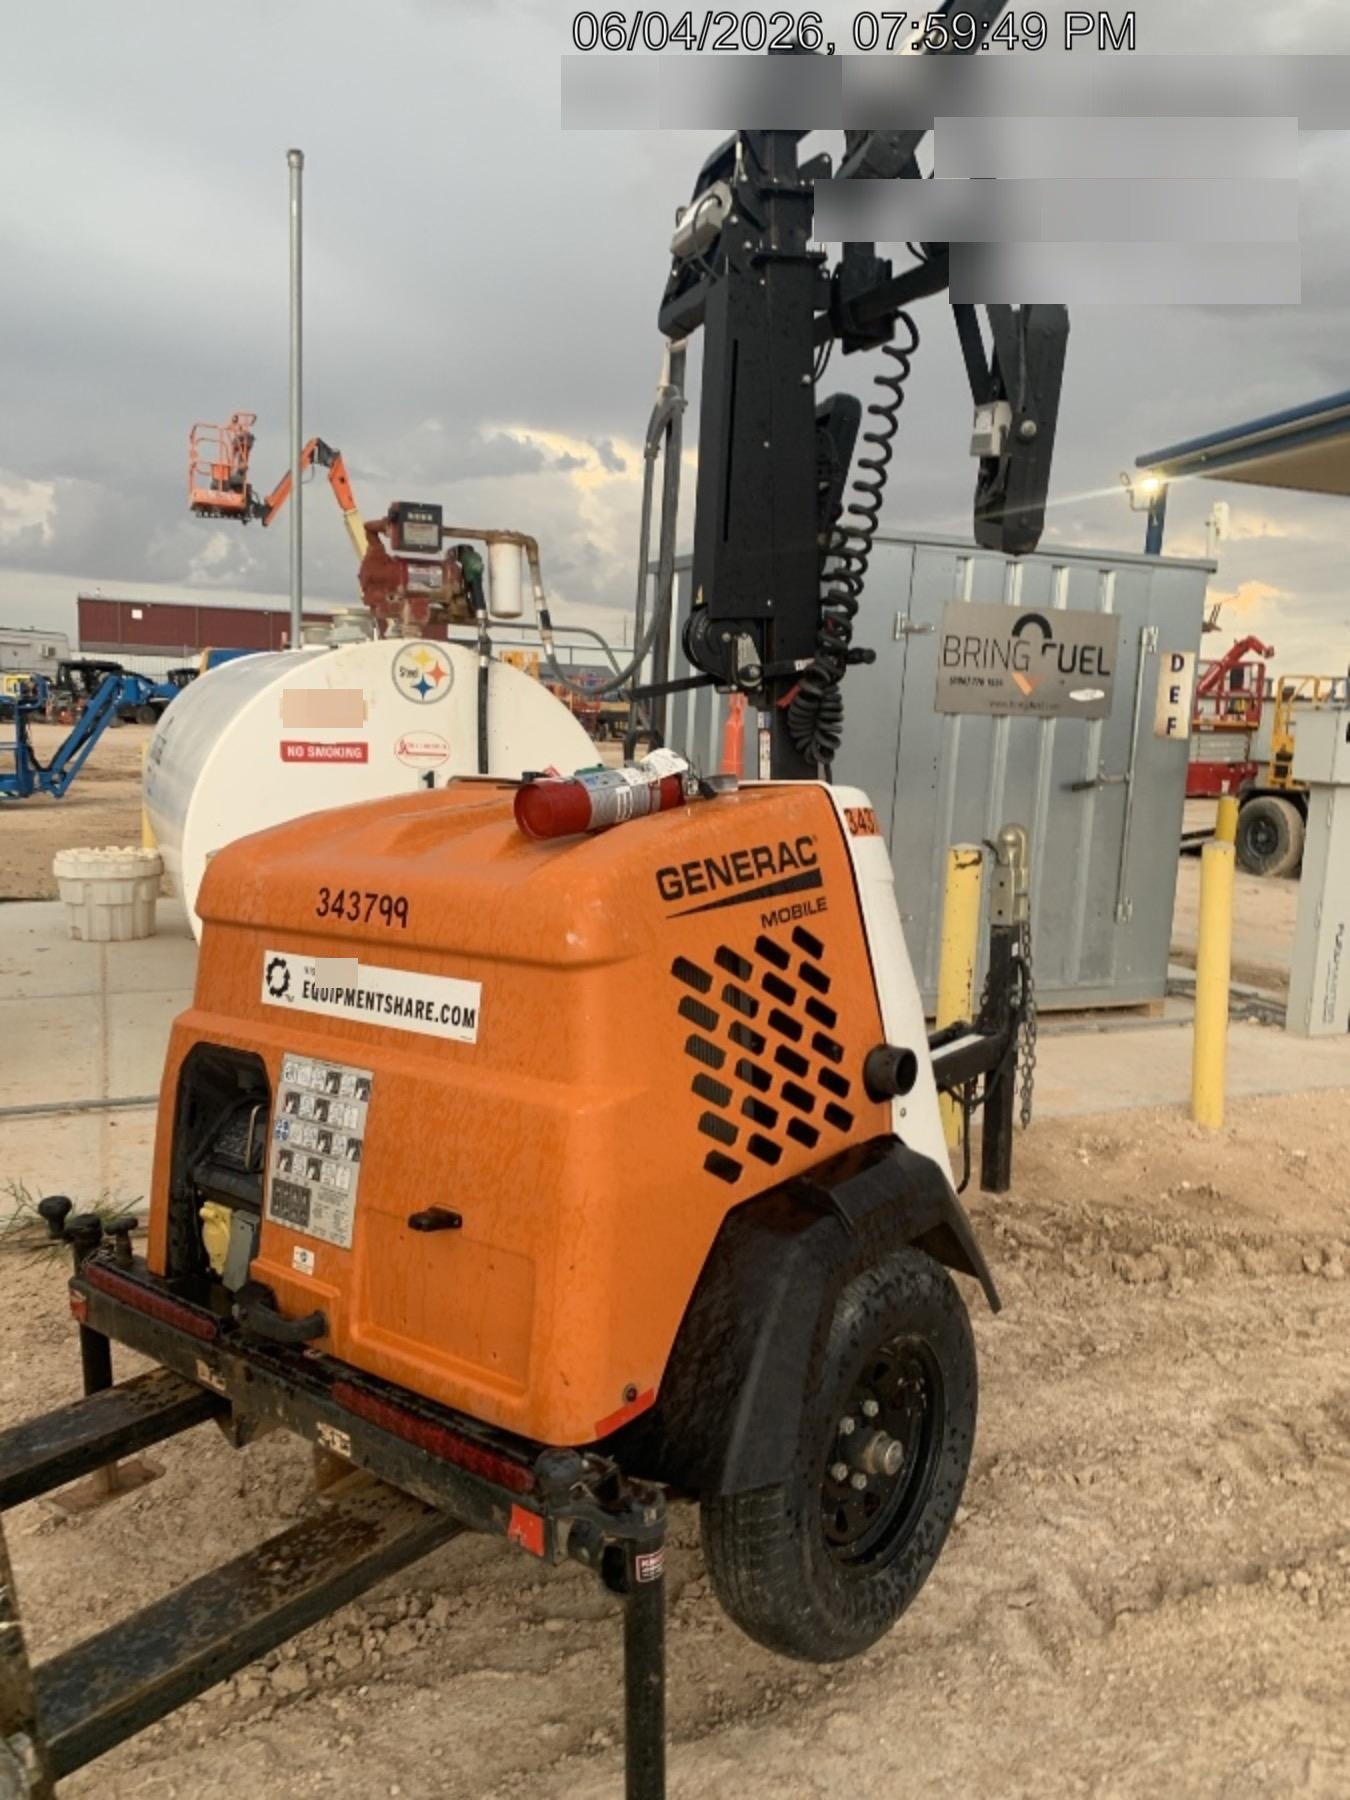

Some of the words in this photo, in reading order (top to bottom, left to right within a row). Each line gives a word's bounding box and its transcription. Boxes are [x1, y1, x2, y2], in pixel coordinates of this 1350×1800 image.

[943, 634, 1030, 673] BRING
[287, 745, 304, 758] NO
[307, 746, 364, 760] SMOKING
[844, 807, 877, 836] 343
[656, 836, 818, 902] GENERAC
[316, 887, 409, 929] 343799
[761, 897, 828, 929] MOBILE
